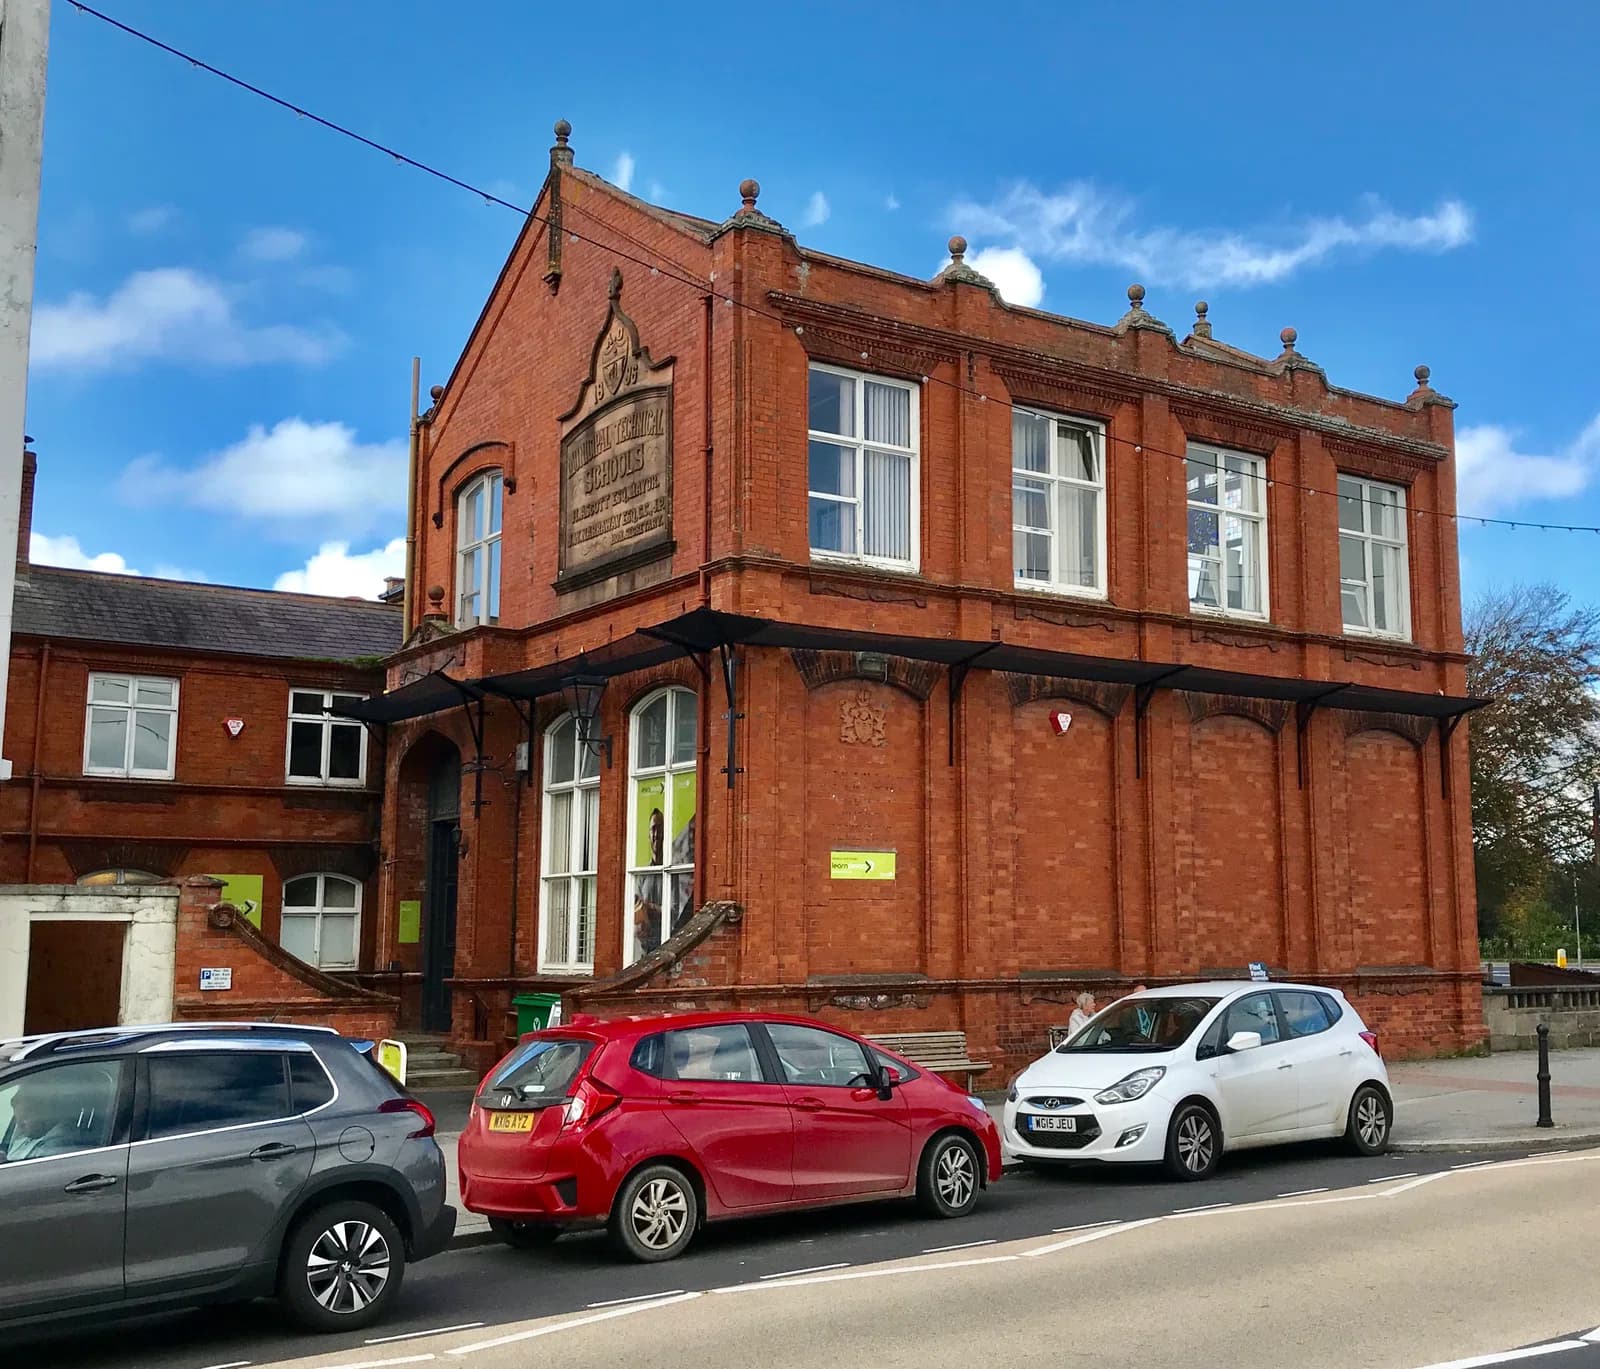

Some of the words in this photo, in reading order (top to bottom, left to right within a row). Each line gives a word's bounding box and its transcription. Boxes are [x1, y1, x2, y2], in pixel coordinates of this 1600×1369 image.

[568, 426, 612, 480] MUNICIPAL
[614, 408, 664, 446] TECHNICAL
[584, 442, 645, 494] SCHOOLS
[511, 1114, 529, 1129] AYZ
[1034, 1117, 1054, 1129] WG15
[1056, 1118, 1073, 1130] JEU
